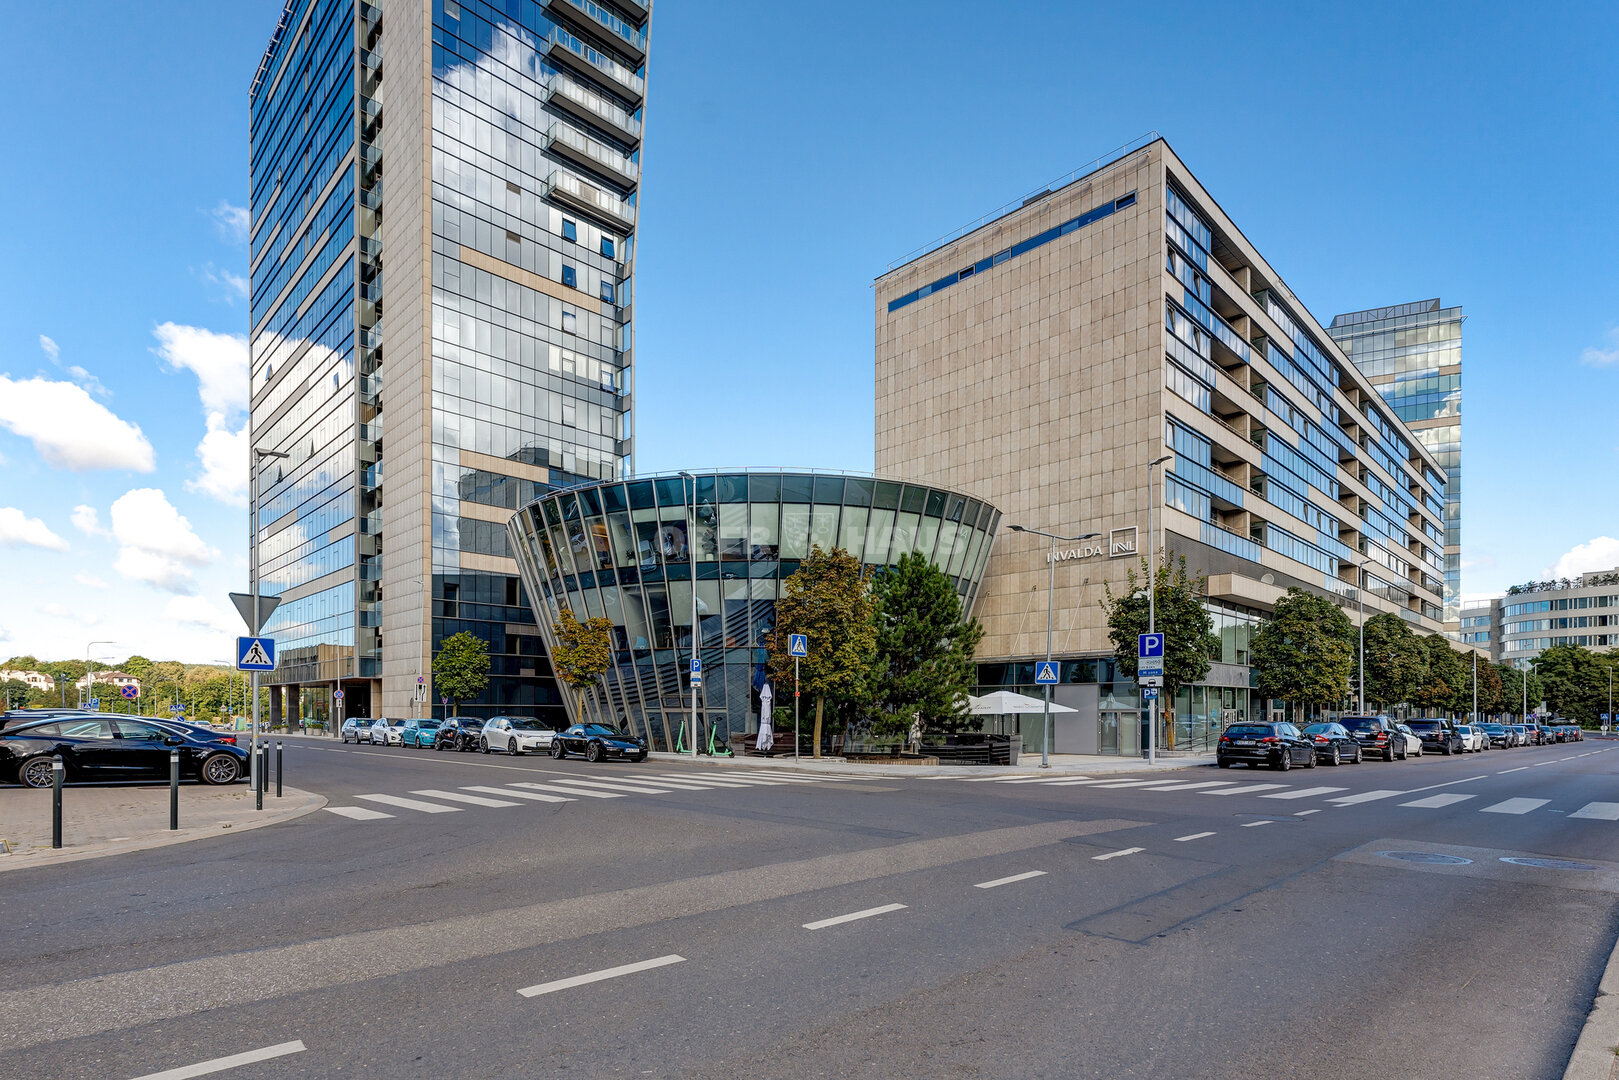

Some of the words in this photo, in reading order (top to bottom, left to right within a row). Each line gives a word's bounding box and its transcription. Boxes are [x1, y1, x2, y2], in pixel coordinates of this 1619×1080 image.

[1047, 546, 1103, 563] INVALDA
[1145, 636, 1159, 655] P
[694, 661, 699, 671] P
[1144, 689, 1150, 699] P
